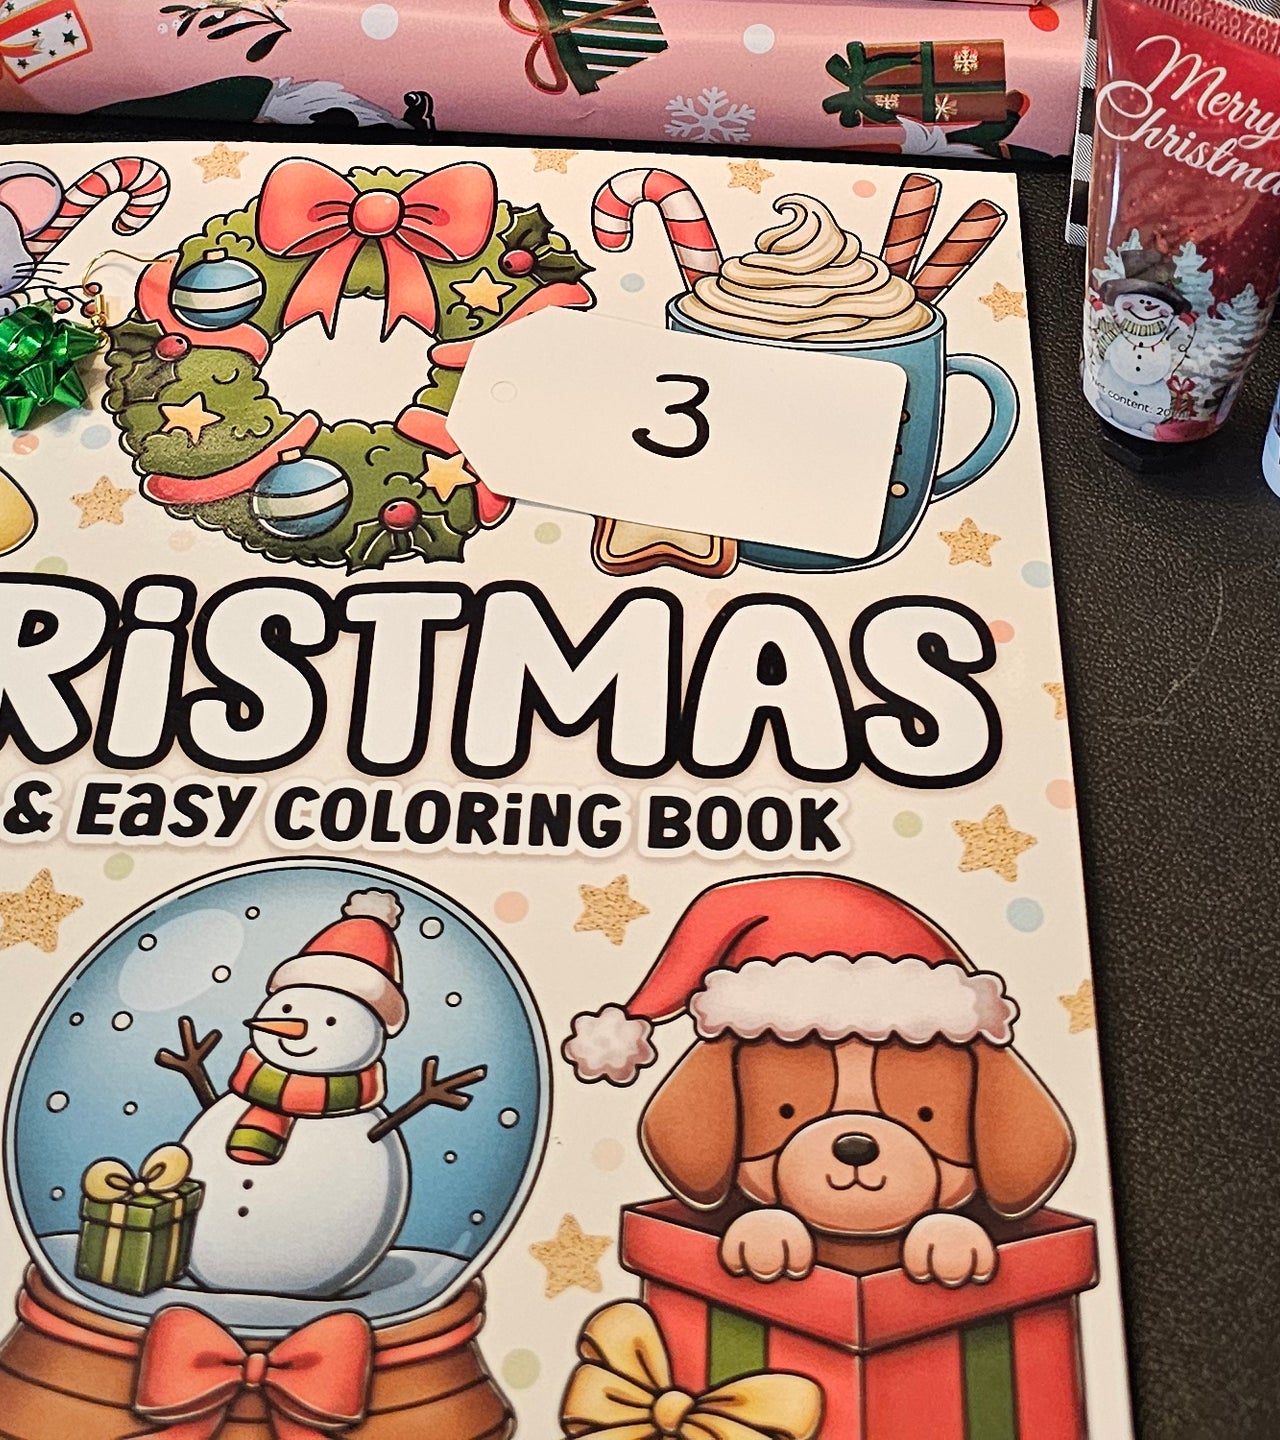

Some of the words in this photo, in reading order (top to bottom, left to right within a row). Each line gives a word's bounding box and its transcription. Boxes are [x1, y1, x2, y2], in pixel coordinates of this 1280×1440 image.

[632, 374, 709, 458] 3
[2, 780, 53, 835] &
[645, 795, 842, 852] BOOK
